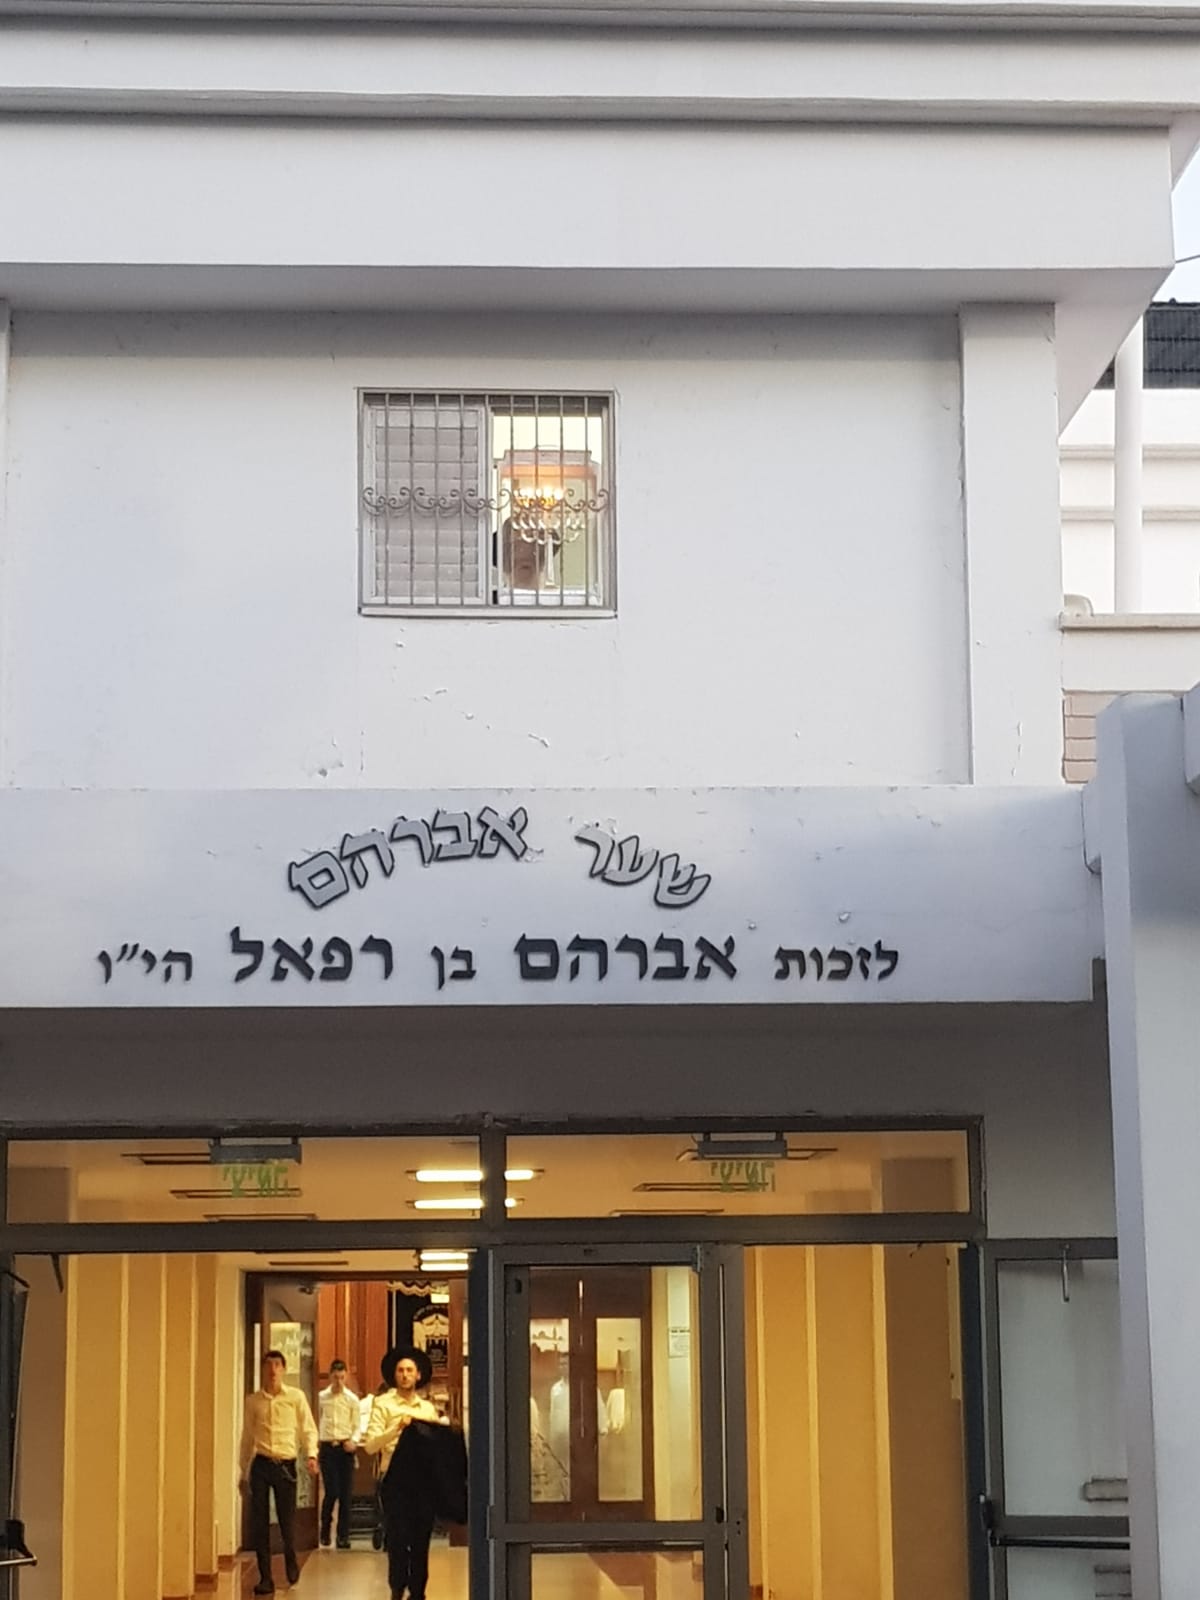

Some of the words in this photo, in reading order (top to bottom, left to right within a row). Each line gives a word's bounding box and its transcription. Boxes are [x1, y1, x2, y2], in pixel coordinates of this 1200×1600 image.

[287, 806, 529, 910] אברהם
[574, 822, 711, 910] שער
[229, 925, 394, 984] רפאל
[430, 945, 477, 991] בן
[513, 932, 738, 982] אברהם
[774, 939, 899, 982] לזכות
